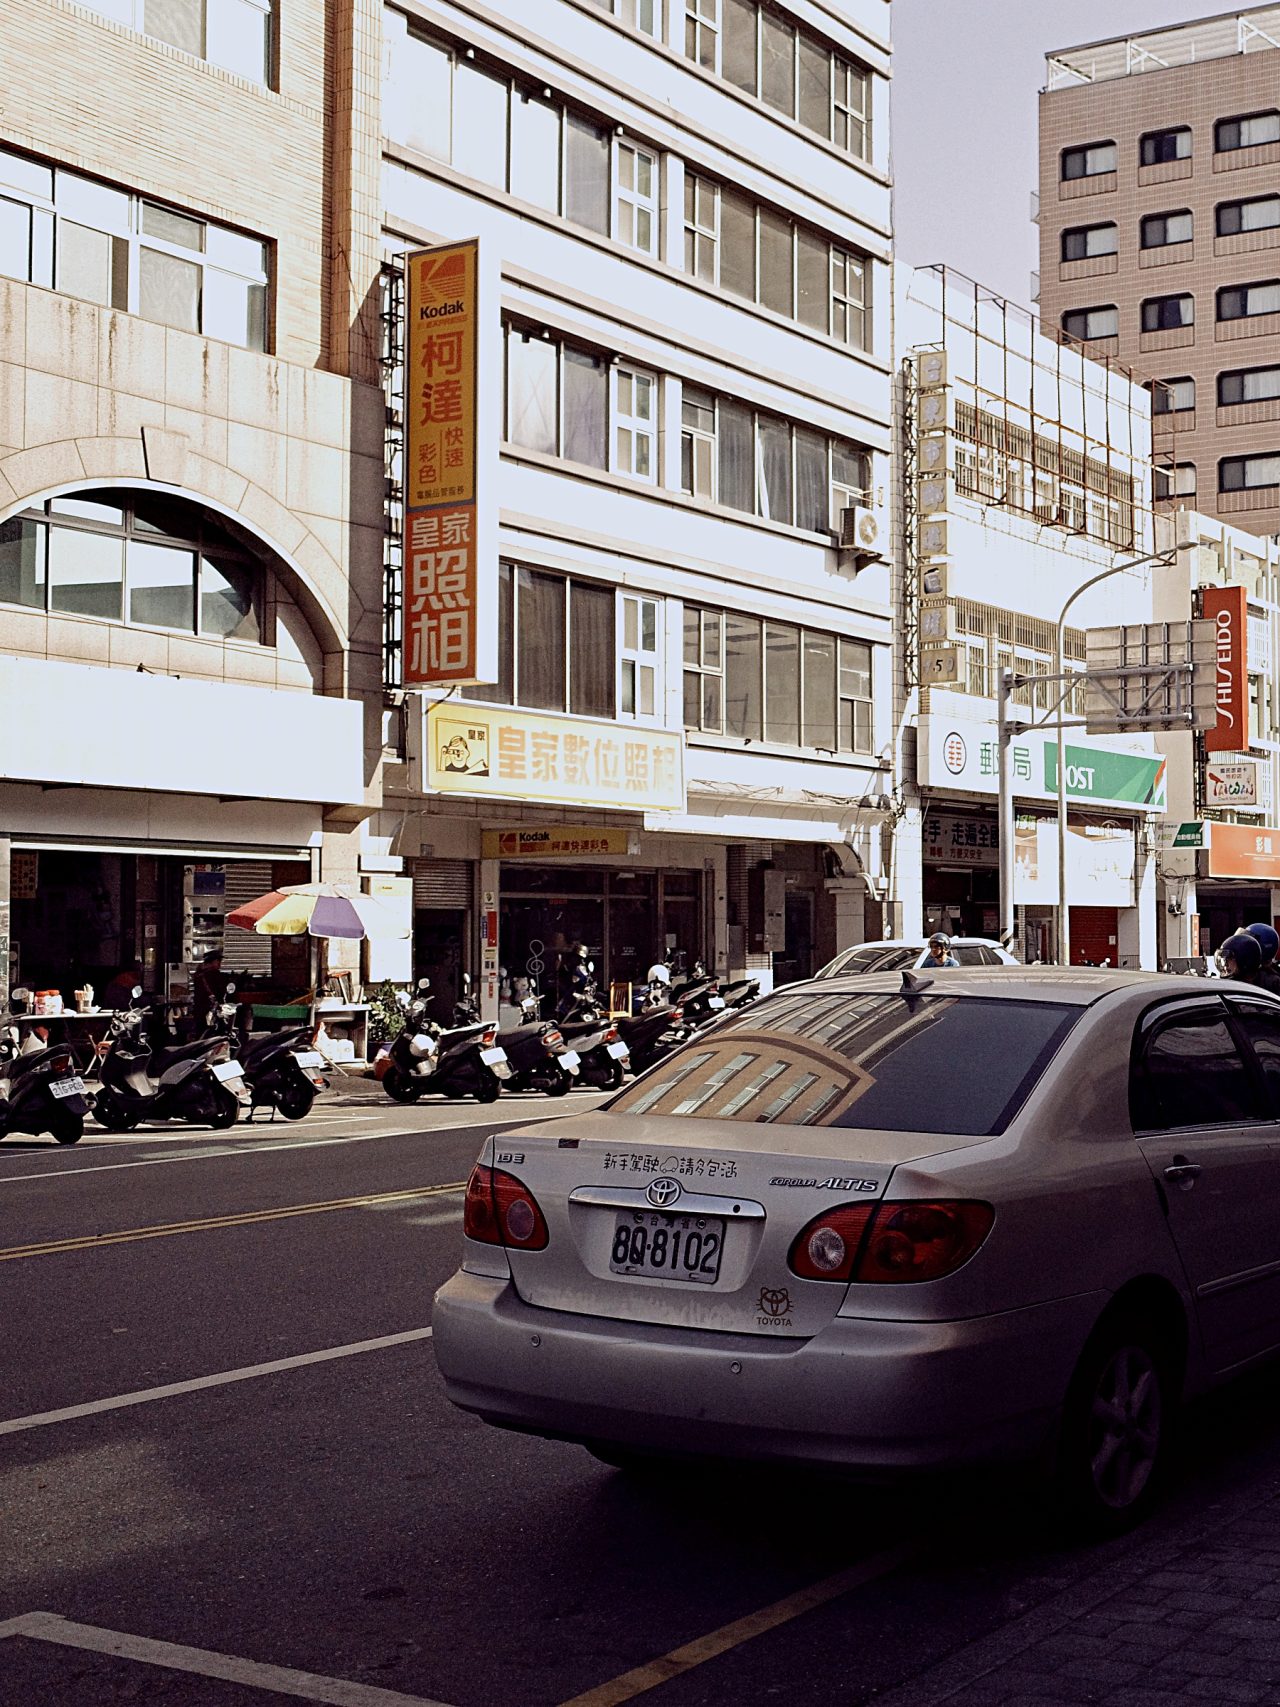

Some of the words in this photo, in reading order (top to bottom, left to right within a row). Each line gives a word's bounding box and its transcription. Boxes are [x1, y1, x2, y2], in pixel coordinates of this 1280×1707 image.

[420, 300, 465, 320] Kodak
[420, 330, 465, 427] 柯達
[445, 426, 464, 468] 快速
[418, 442, 437, 484] 彩色
[411, 512, 470, 549] 皇家
[410, 548, 470, 674] 照相
[1216, 609, 1234, 729] SHISEIDO
[468, 729, 485, 742] 皇家
[498, 726, 676, 792] 皇家數位照相
[1056, 763, 1095, 790] OST
[519, 832, 550, 842] Kodak
[552, 839, 609, 851] 柯達快速彩色
[603, 1152, 659, 1173] 新手駕駛
[679, 1157, 738, 1178] 請多包涵
[816, 1177, 879, 1192] ALTIS
[756, 1317, 793, 1326] TOYOTA
